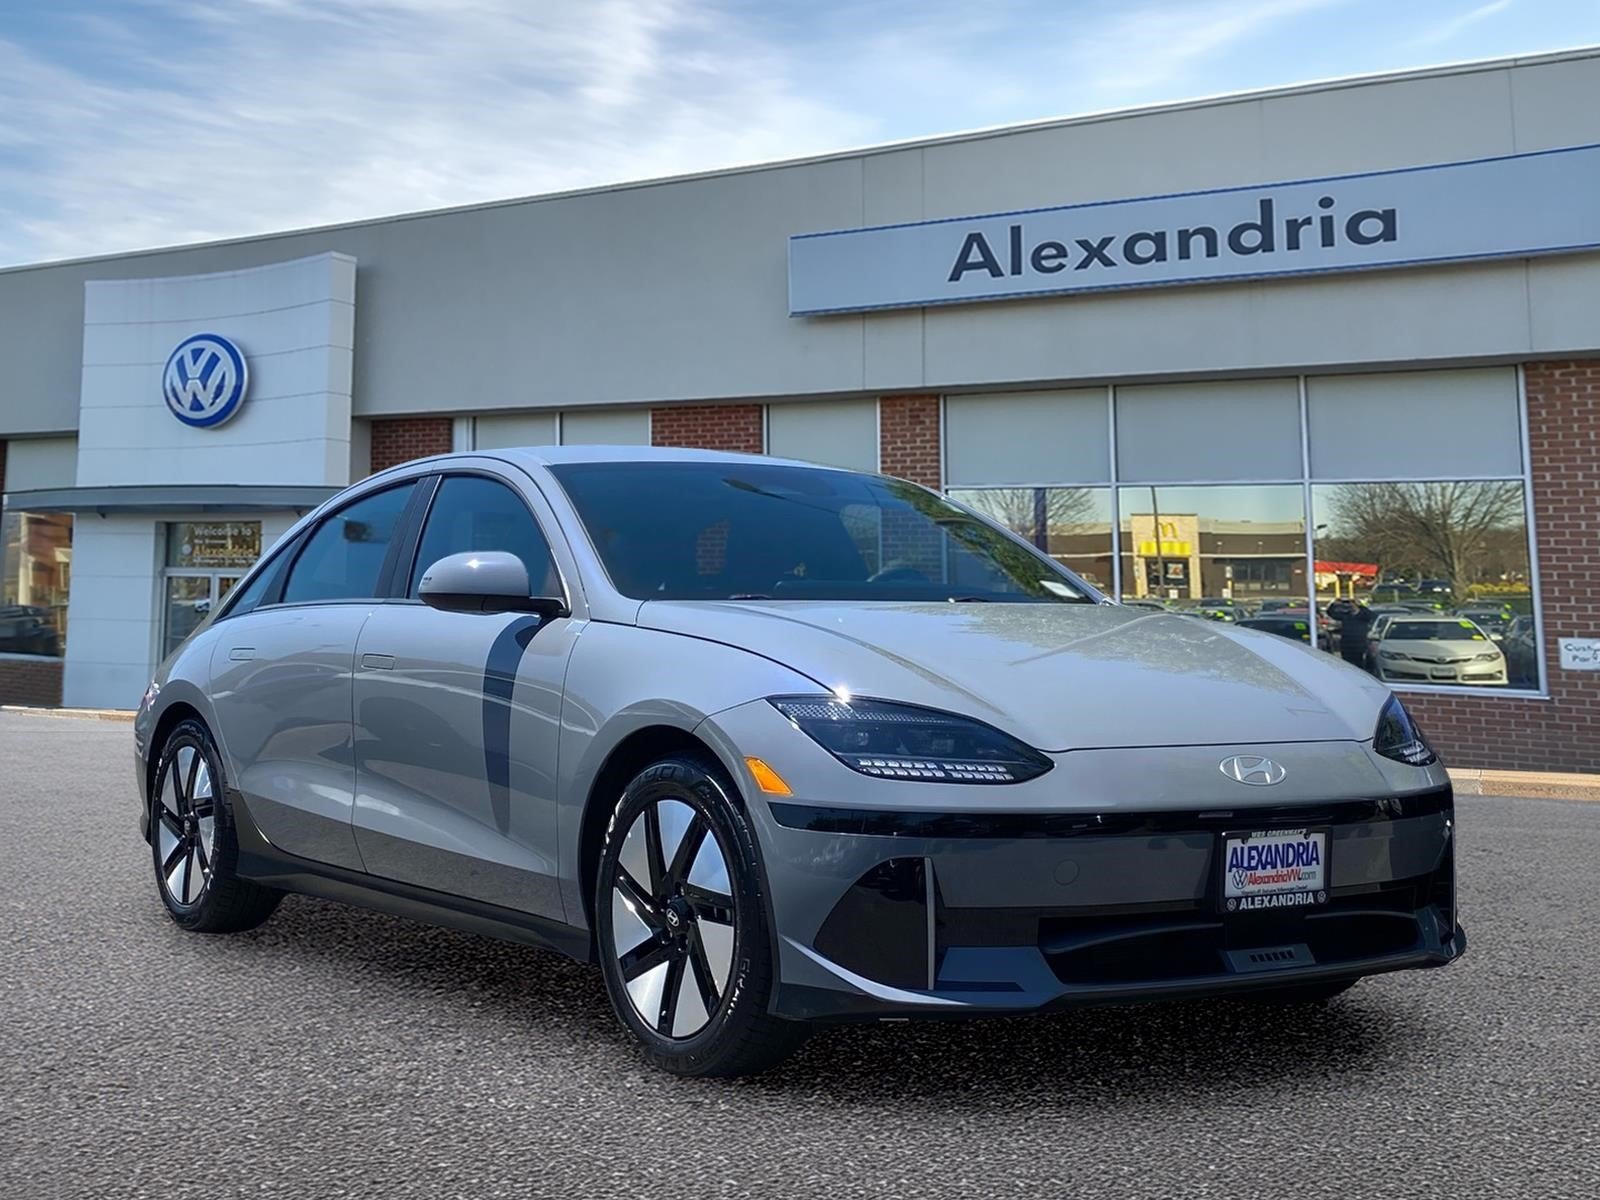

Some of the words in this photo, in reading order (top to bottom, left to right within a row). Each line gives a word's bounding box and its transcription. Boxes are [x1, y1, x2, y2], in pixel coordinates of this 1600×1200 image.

[948, 196, 1398, 282] Alexandria
[194, 527, 239, 536] Welcome
[241, 527, 252, 536] to
[1228, 841, 1320, 872] ALEXANDRIA
[1239, 892, 1315, 910] ALEXANDRIA
